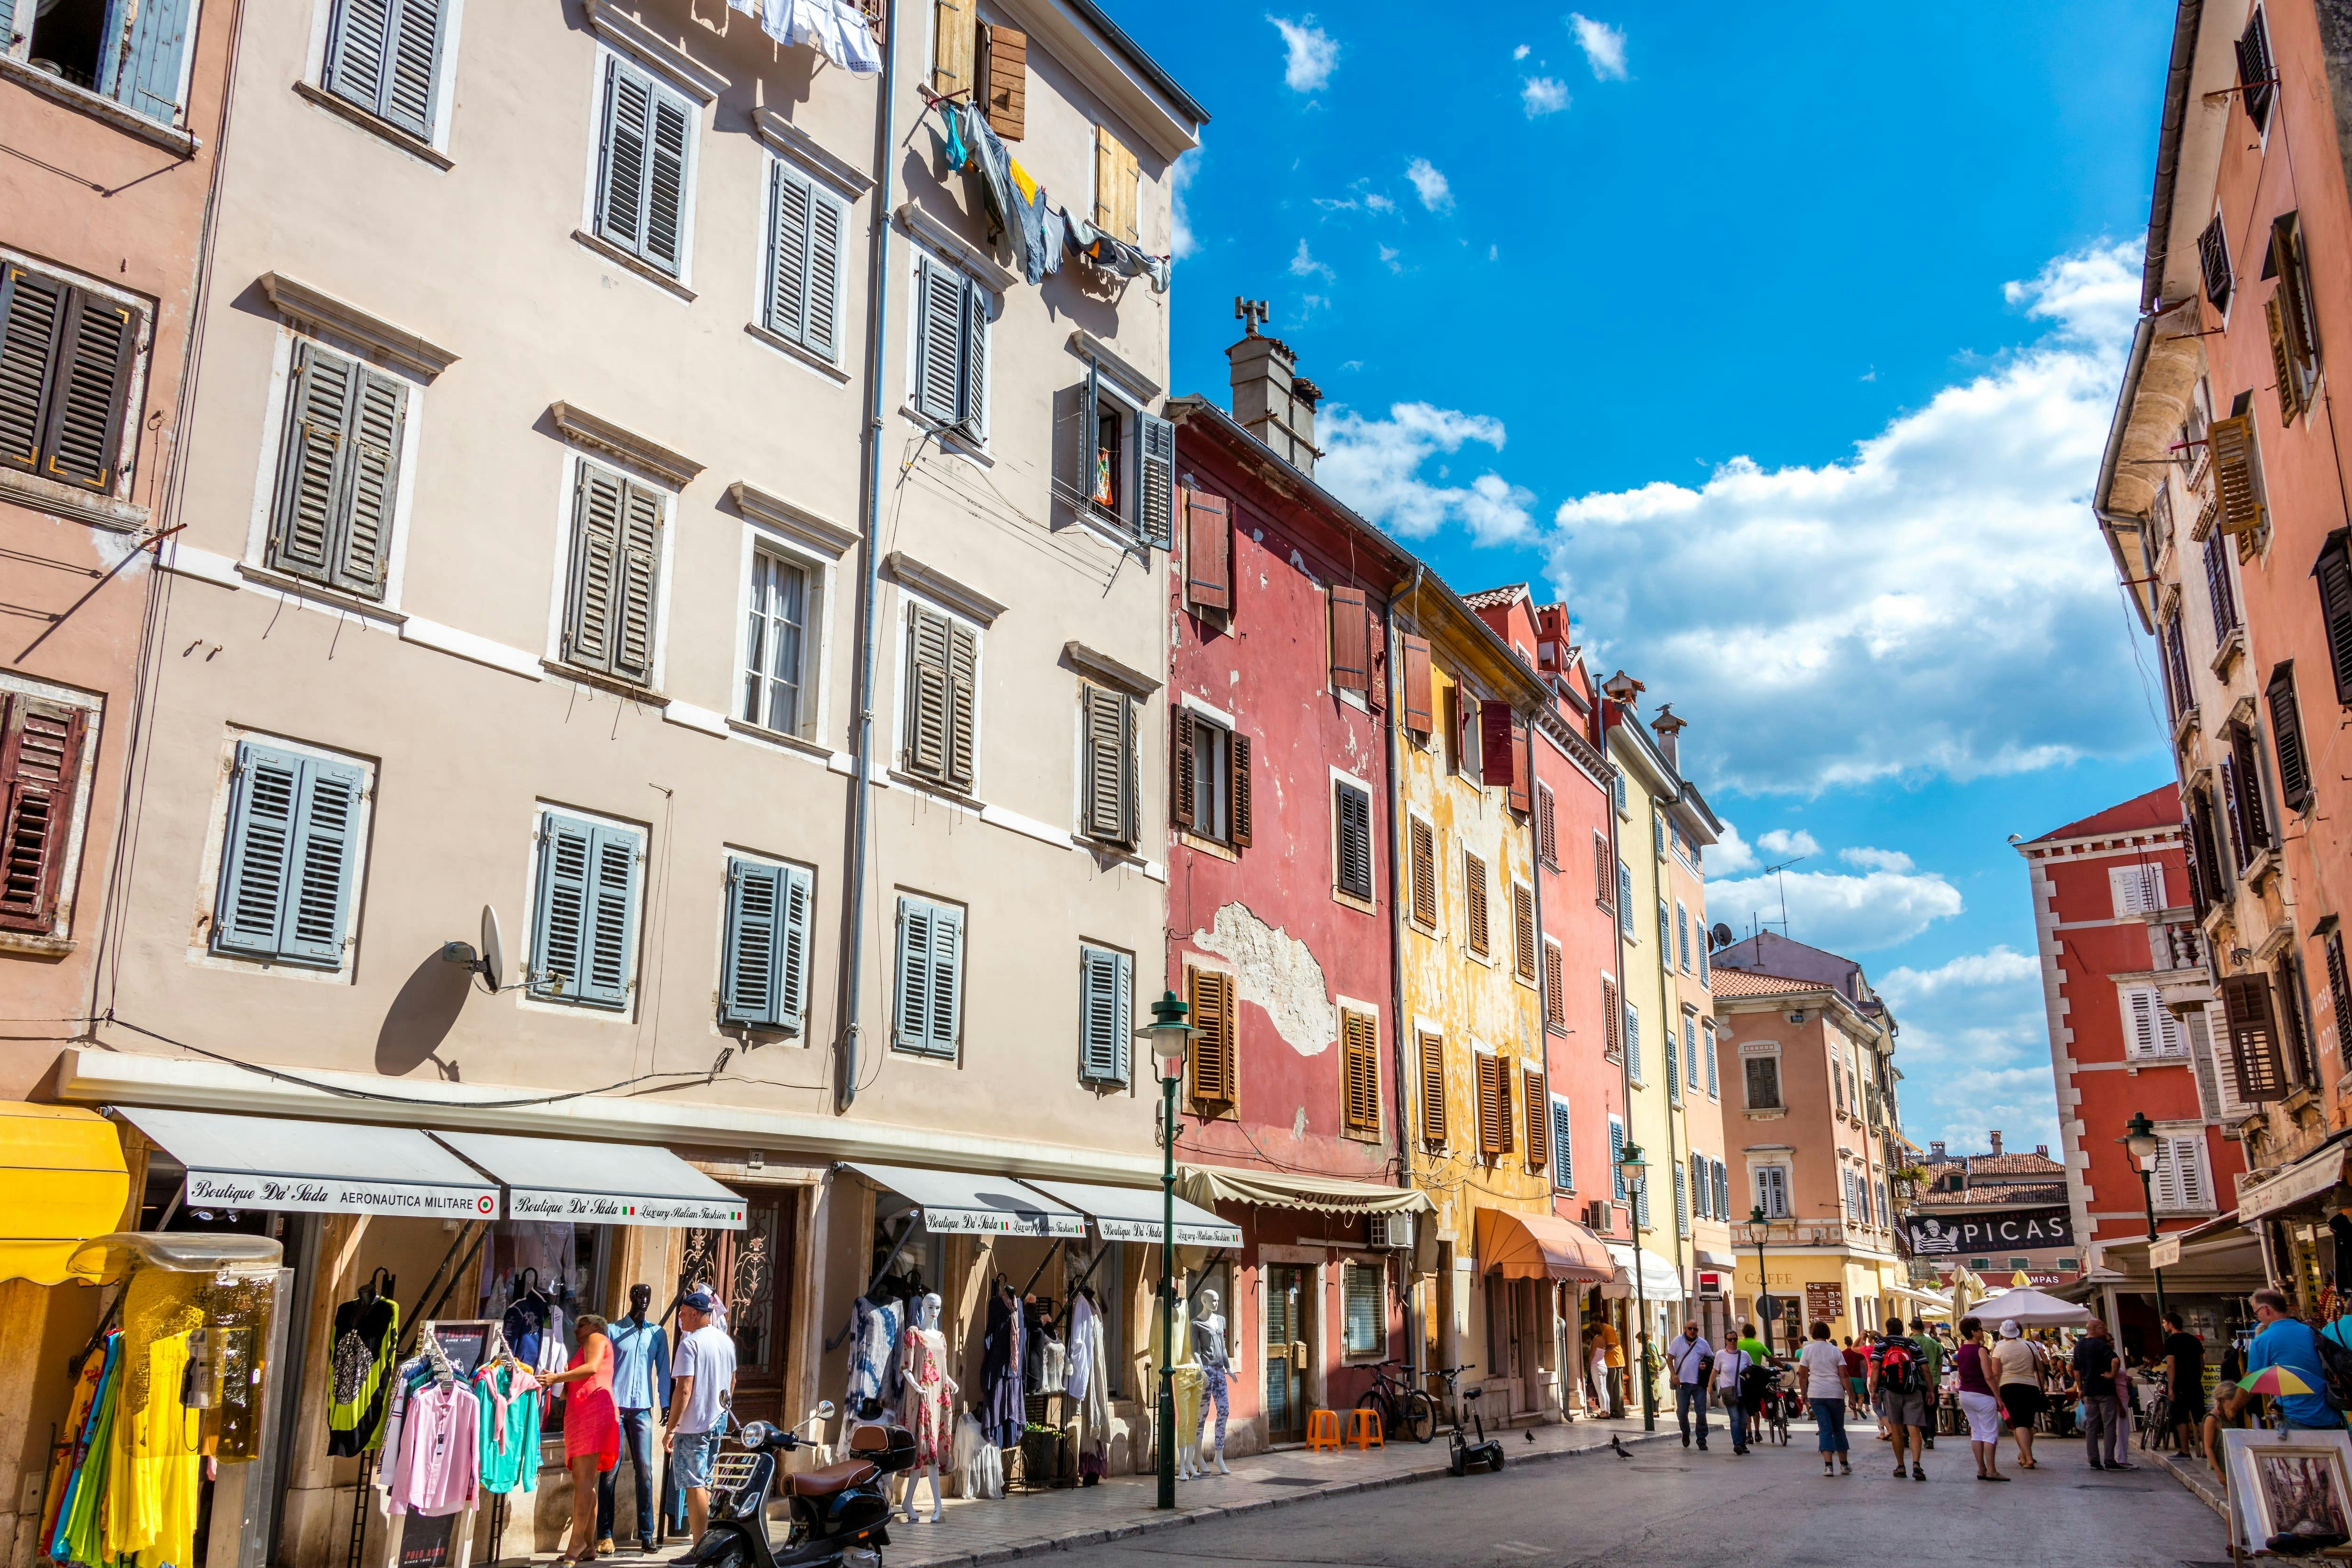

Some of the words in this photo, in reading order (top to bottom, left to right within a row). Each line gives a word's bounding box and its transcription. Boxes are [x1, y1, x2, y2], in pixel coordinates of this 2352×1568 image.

[2312, 984, 2331, 1017] VIDEO
[755, 1154, 759, 1163] 7
[191, 1180, 255, 1203] Boutique
[291, 1184, 329, 1202] Sada
[340, 1192, 421, 1207] AERONAUTICA
[425, 1197, 473, 1210] MILITARE
[1294, 1191, 1370, 1208] SOUVENIR
[515, 1196, 563, 1217] Boutique
[590, 1199, 618, 1215] Sada
[639, 1205, 669, 1221] Luxury
[671, 1207, 698, 1219] Italian
[927, 1214, 959, 1232] Boutique
[978, 1215, 998, 1230] Sada
[1013, 1220, 1034, 1234] Luxury
[1034, 1221, 1055, 1233] Italian
[1104, 1222, 1131, 1239] Boutique
[1146, 1224, 1162, 1238] Sada
[1177, 1228, 1196, 1242] Luxury
[1196, 1231, 1213, 1241] Italian
[1963, 1218, 2064, 1243] PICAS
[416, 1328, 425, 1351] ASSN
[405, 1550, 424, 1560] POLO
[427, 1547, 445, 1558] ASSN
